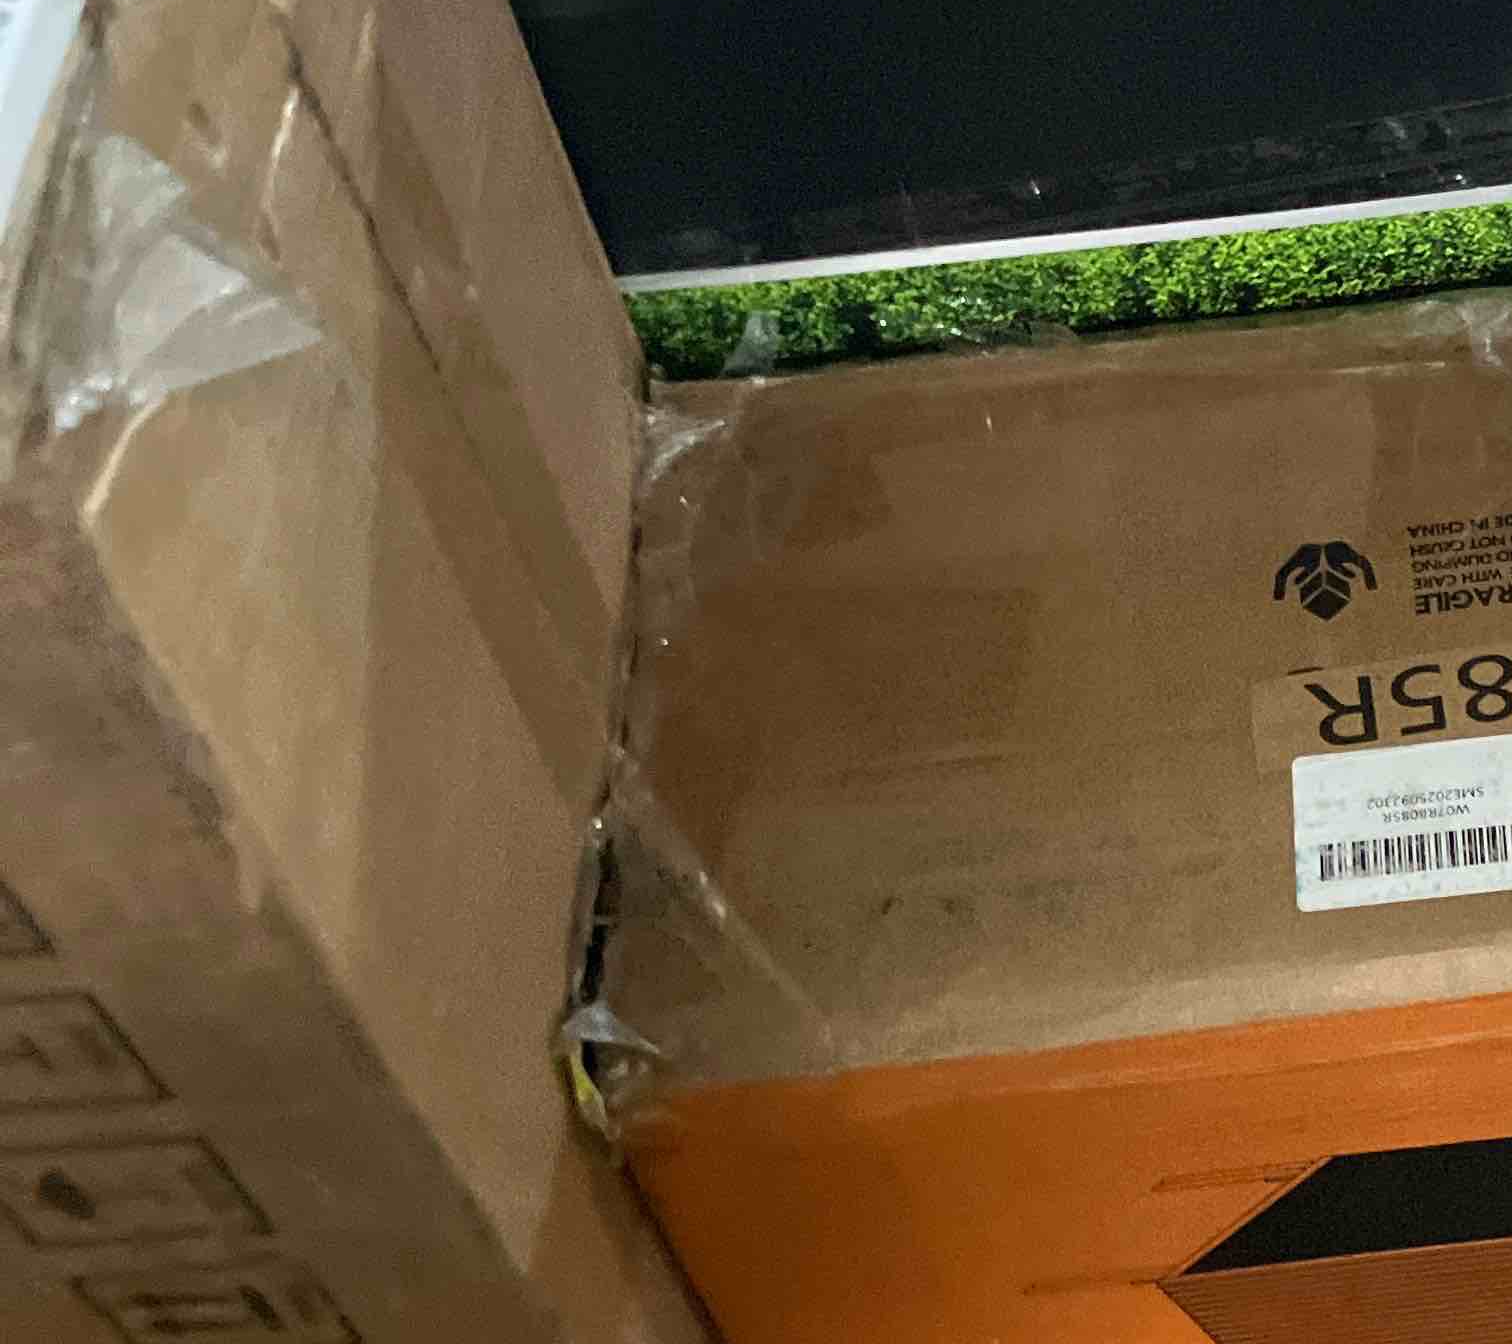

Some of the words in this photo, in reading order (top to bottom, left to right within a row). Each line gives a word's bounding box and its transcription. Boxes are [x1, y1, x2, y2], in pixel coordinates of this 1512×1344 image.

[1406, 521, 1464, 538] CHINA
[1470, 517, 1489, 530] IN
[1471, 535, 1505, 549] NOT
[1411, 552, 1492, 573] DUMPING
[1414, 574, 1457, 591] CARE
[1462, 568, 1502, 585] WITH
